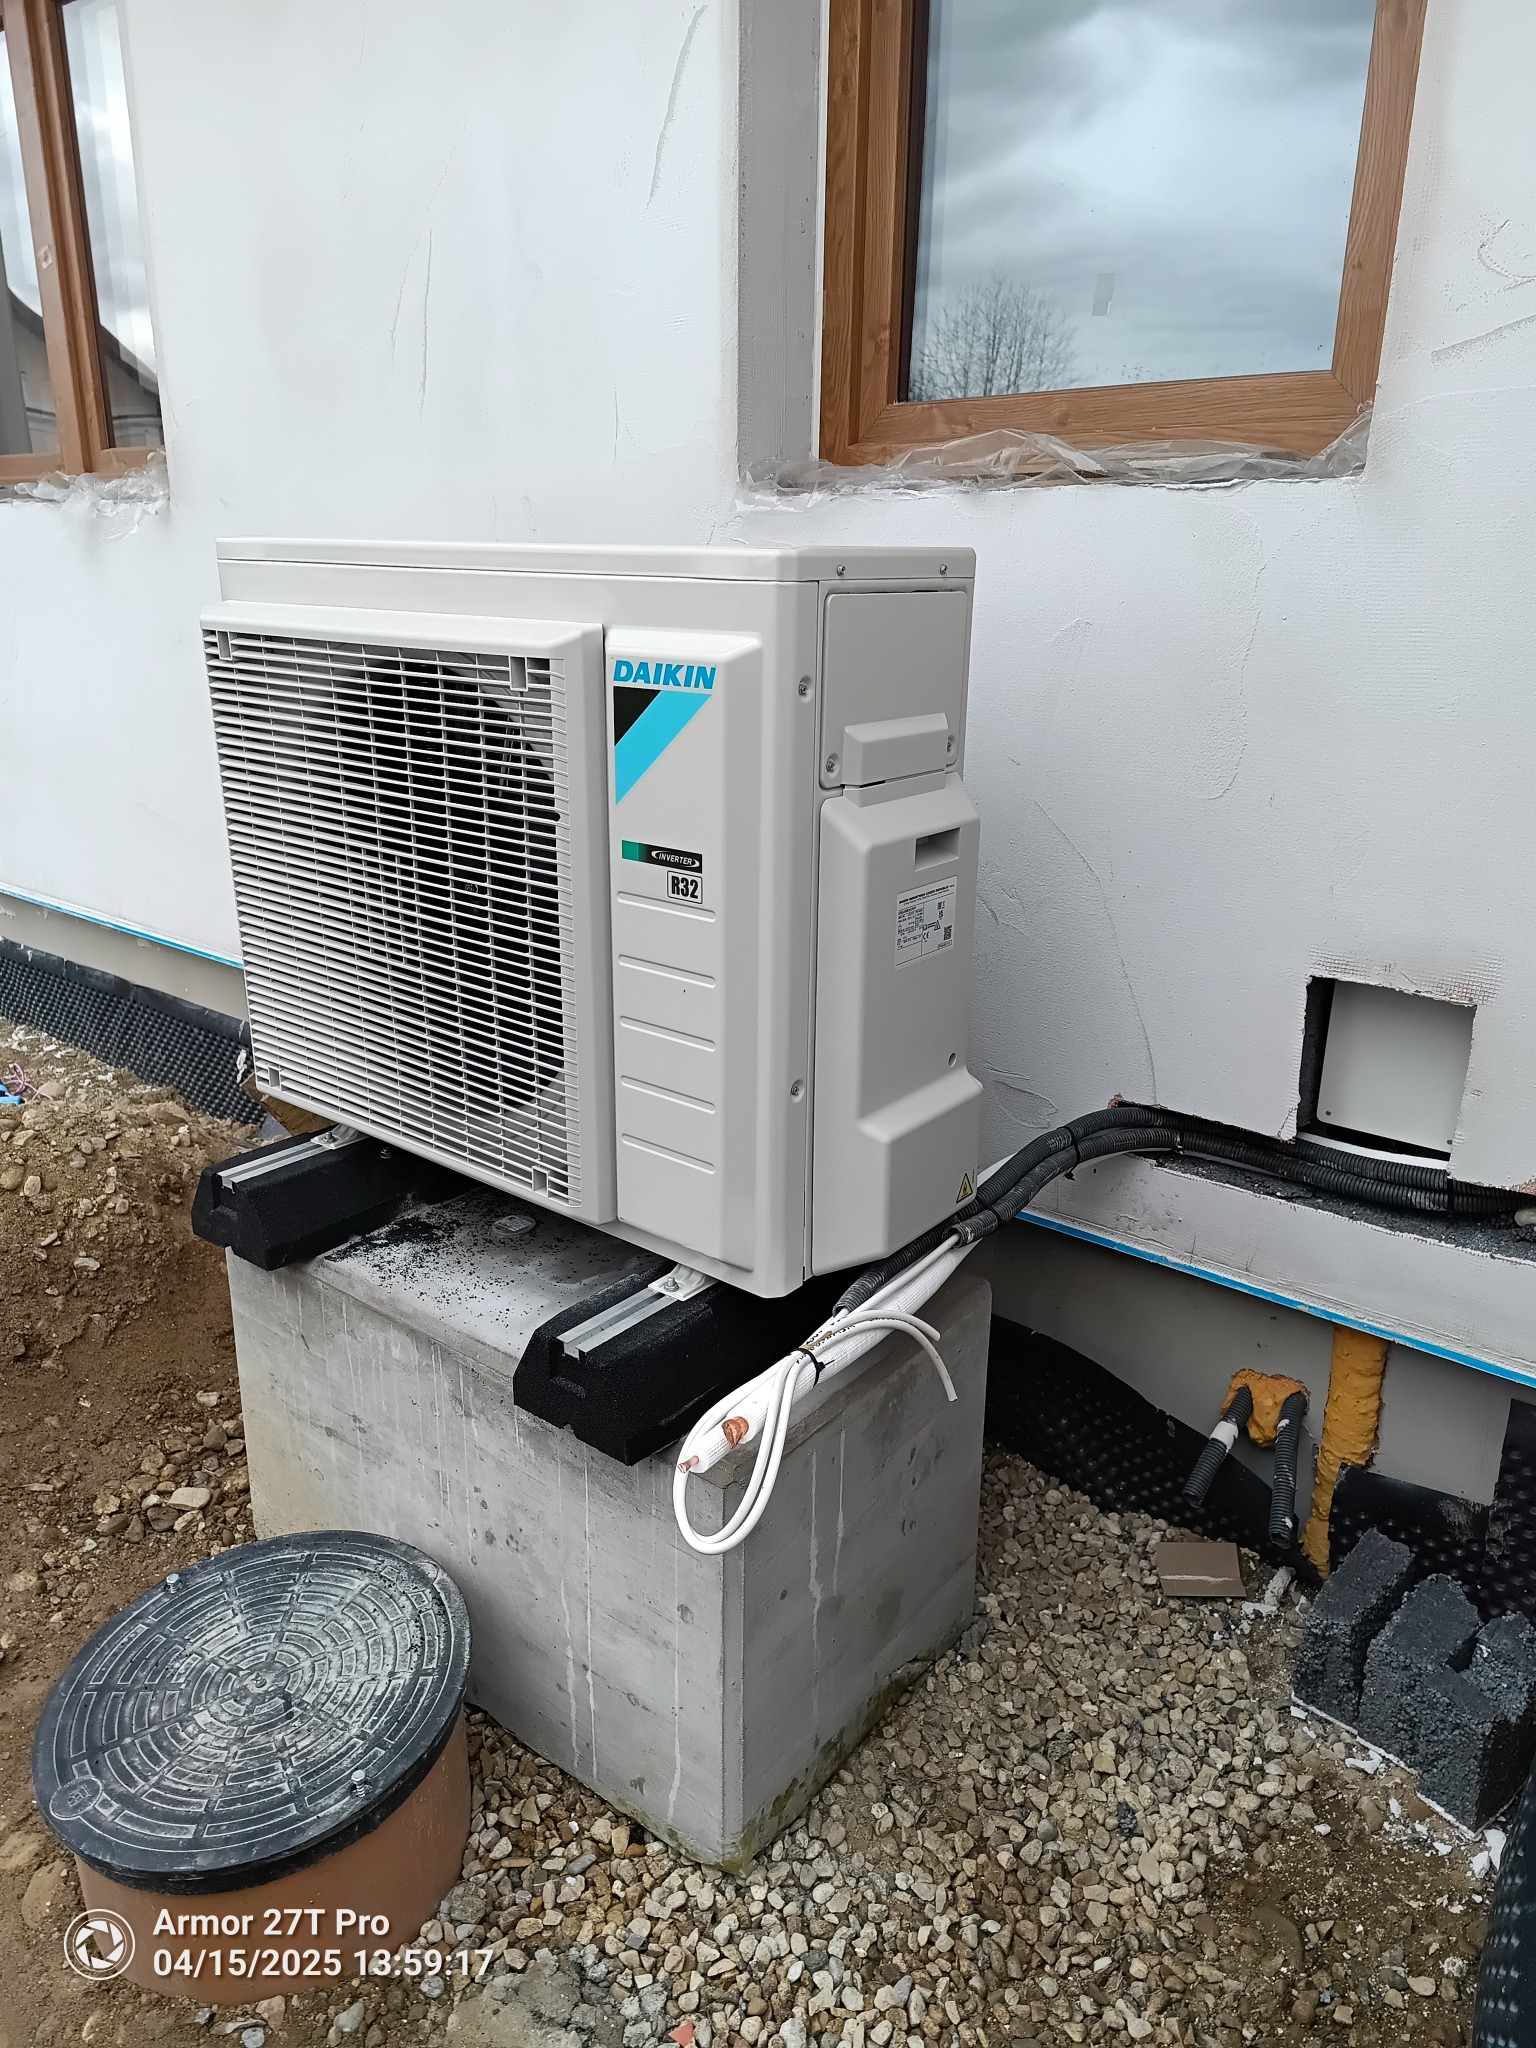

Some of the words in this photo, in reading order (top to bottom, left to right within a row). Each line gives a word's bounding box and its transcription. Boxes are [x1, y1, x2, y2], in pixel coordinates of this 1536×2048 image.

[613, 660, 716, 690] DAIKIN
[658, 852, 693, 866] INVERTER
[671, 875, 699, 899] R32
